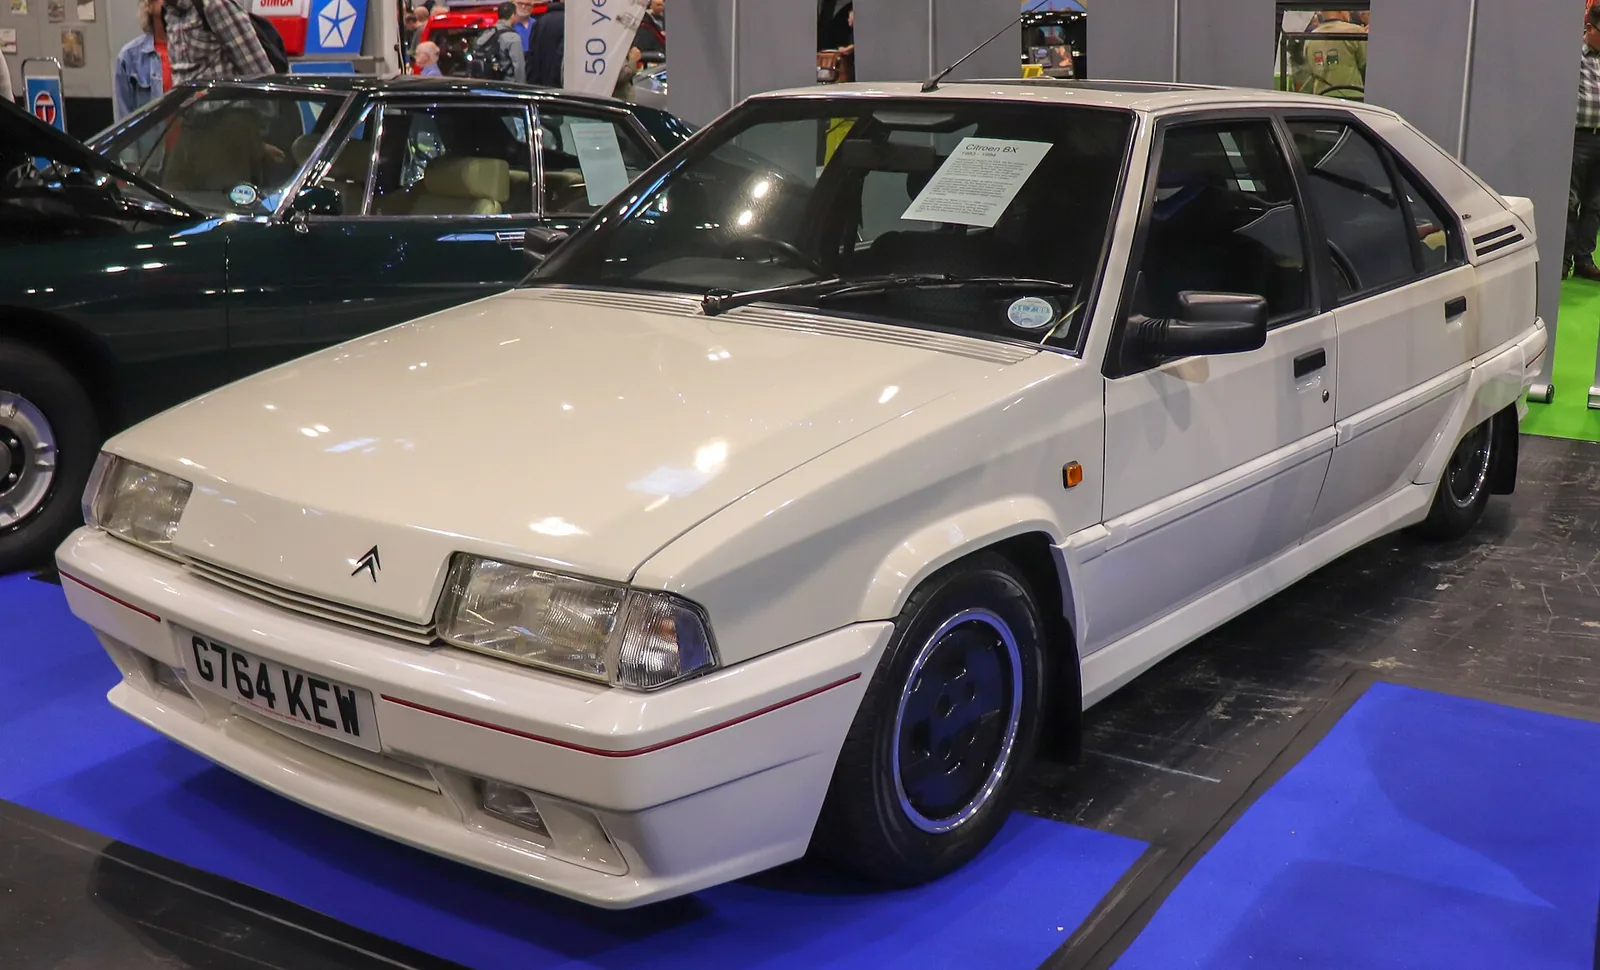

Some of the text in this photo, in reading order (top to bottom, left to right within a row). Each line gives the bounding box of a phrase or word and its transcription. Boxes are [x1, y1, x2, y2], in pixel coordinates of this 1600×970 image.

[585, 38, 606, 75] 50
[965, 143, 1020, 154] Citroen BX
[192, 635, 276, 709] G764
[282, 669, 360, 737] KEW
